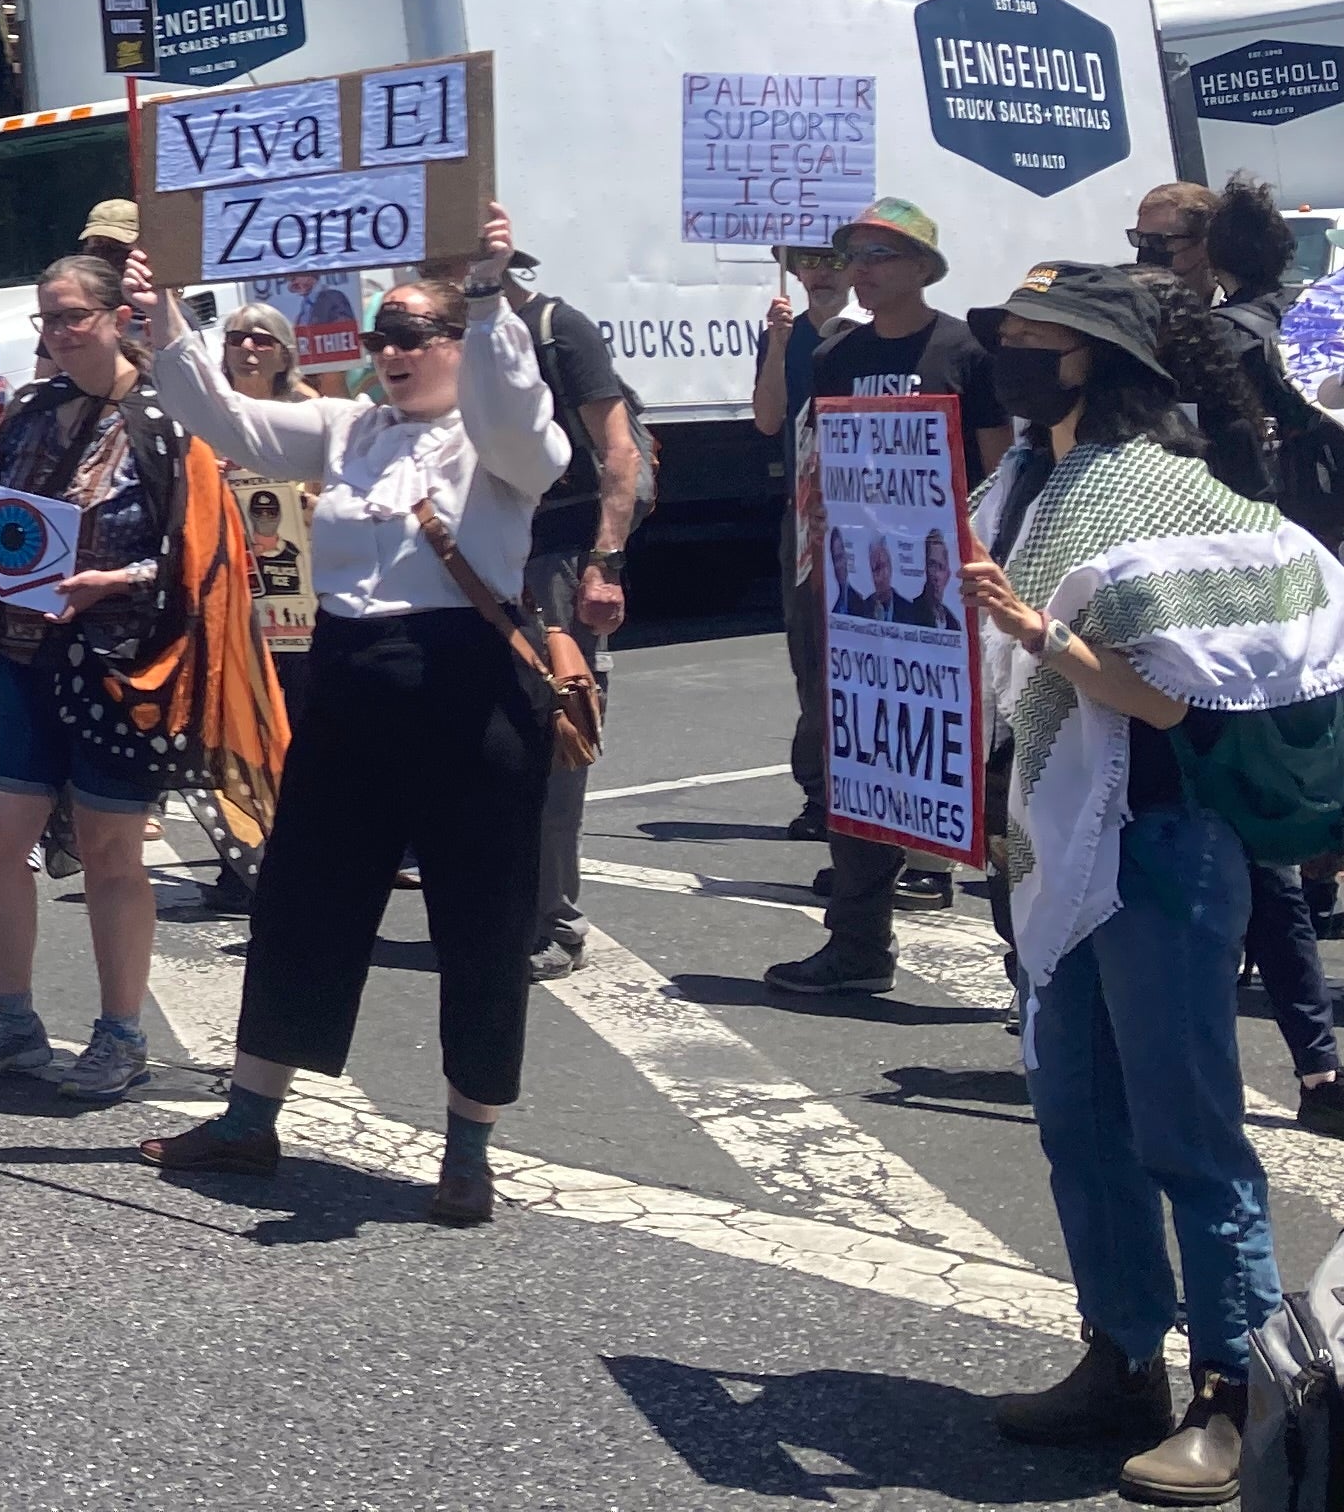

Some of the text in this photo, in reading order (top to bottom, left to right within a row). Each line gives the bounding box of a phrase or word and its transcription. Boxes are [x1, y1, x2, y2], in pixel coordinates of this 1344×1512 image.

[179, 36, 220, 54] SALES
[229, 23, 288, 45] RENTALS
[935, 37, 1106, 102] HENGEHOLD
[1200, 60, 1337, 96] HENGEHOLD
[688, 75, 872, 110] PALANTIR
[1203, 93, 1240, 107] TRUCK
[1243, 89, 1279, 102] SALES
[1289, 82, 1339, 97] RENTALS
[173, 75, 454, 173] Viva El
[704, 109, 863, 141] SUPPORTS
[946, 97, 996, 122] TRUCK
[999, 99, 1043, 125] SALES
[1055, 106, 1111, 130] RENTALS
[706, 143, 862, 175] ILLEGAL
[1014, 153, 1066, 170] PALO ALTO
[734, 176, 822, 208] ICE
[218, 198, 409, 265] Zorro
[315, 331, 358, 354] THIEL
[852, 374, 921, 396] MUSIC
[822, 418, 862, 454] THEY
[870, 418, 940, 456] BLAME
[825, 467, 946, 508] IMMIGRANTS
[830, 647, 960, 703] SO YOU DON'T
[832, 689, 964, 788] BLAME
[832, 775, 965, 843] BILLIONAIRES
